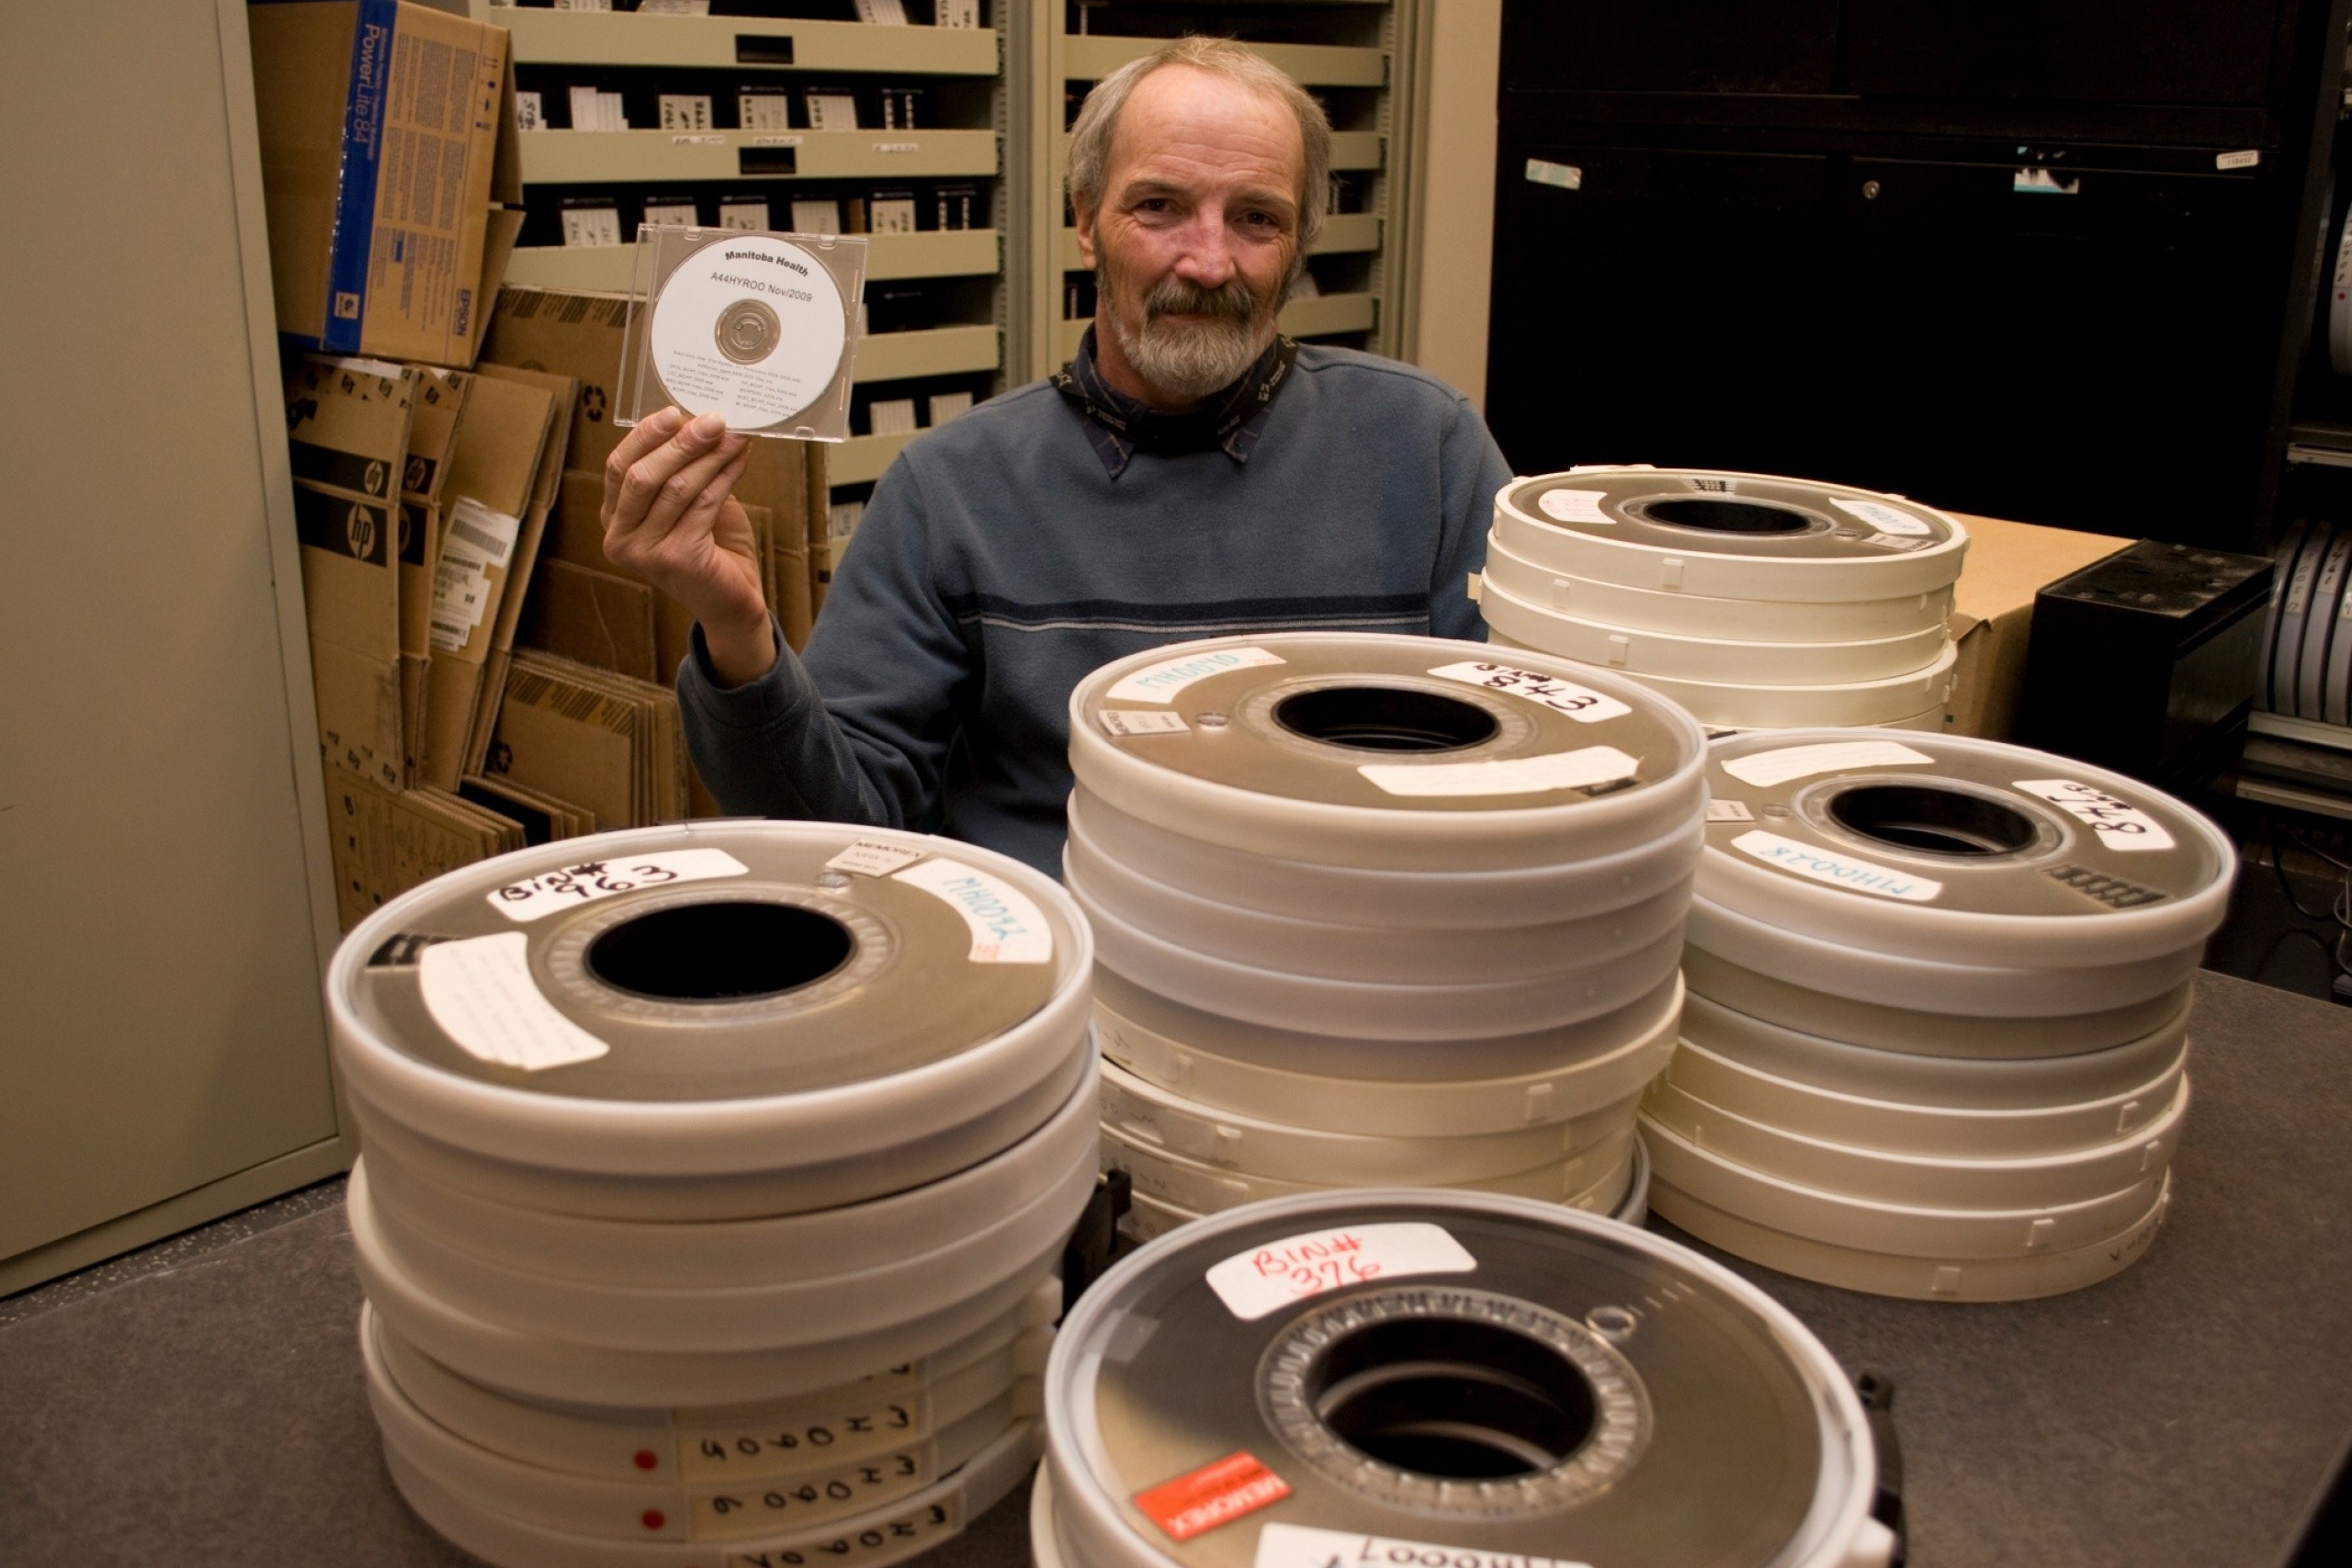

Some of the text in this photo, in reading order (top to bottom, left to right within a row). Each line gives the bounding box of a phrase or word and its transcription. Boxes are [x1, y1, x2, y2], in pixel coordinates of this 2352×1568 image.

[355, 23, 380, 116] PowerLite
[353, 118, 370, 143] 84
[725, 251, 808, 277] Manitoba Health
[456, 288, 471, 336] EPSON
[767, 284, 813, 302] Nov/2009
[350, 502, 374, 560] hp
[1482, 675, 1599, 710] 843
[554, 865, 679, 898] 963
[1760, 846, 1913, 895] MH0028
[1252, 1234, 1363, 1277] BIN#
[1290, 1255, 1381, 1297] 376
